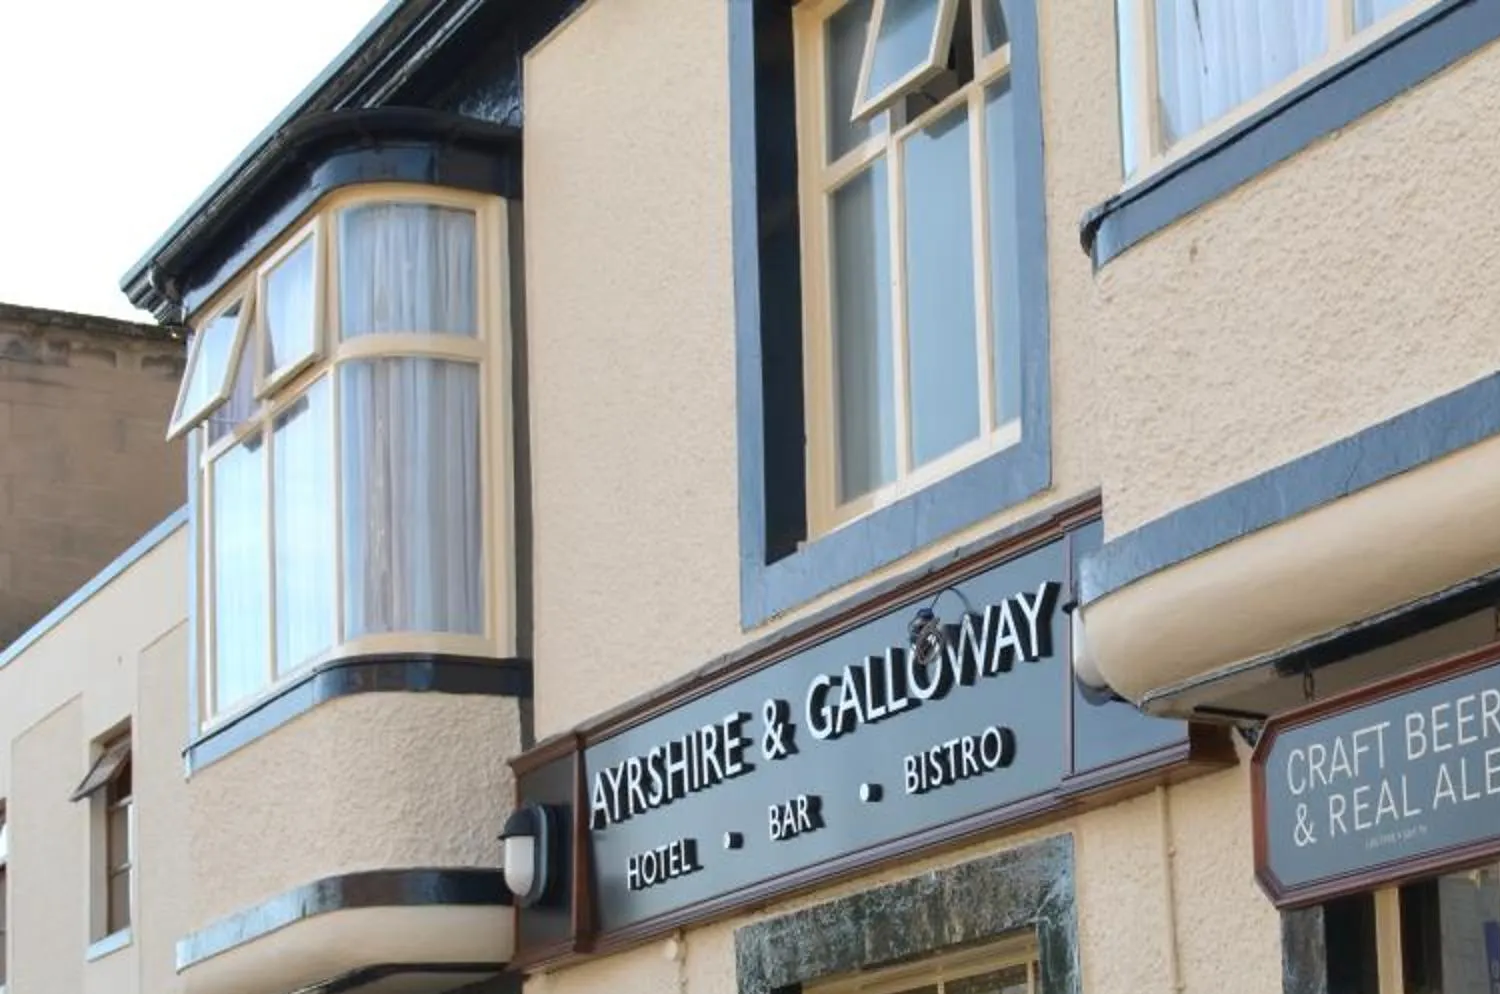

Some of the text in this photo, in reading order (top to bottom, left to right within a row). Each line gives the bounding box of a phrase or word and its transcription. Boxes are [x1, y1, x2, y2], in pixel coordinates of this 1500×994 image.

[589, 581, 1061, 830] AYRSHIRE & GALLOWAY
[1286, 721, 1391, 796] CRAFT
[627, 725, 1008, 892] HOTEL BAR BISTRO
[1293, 802, 1317, 847] &
[1328, 775, 1423, 840] REAL
